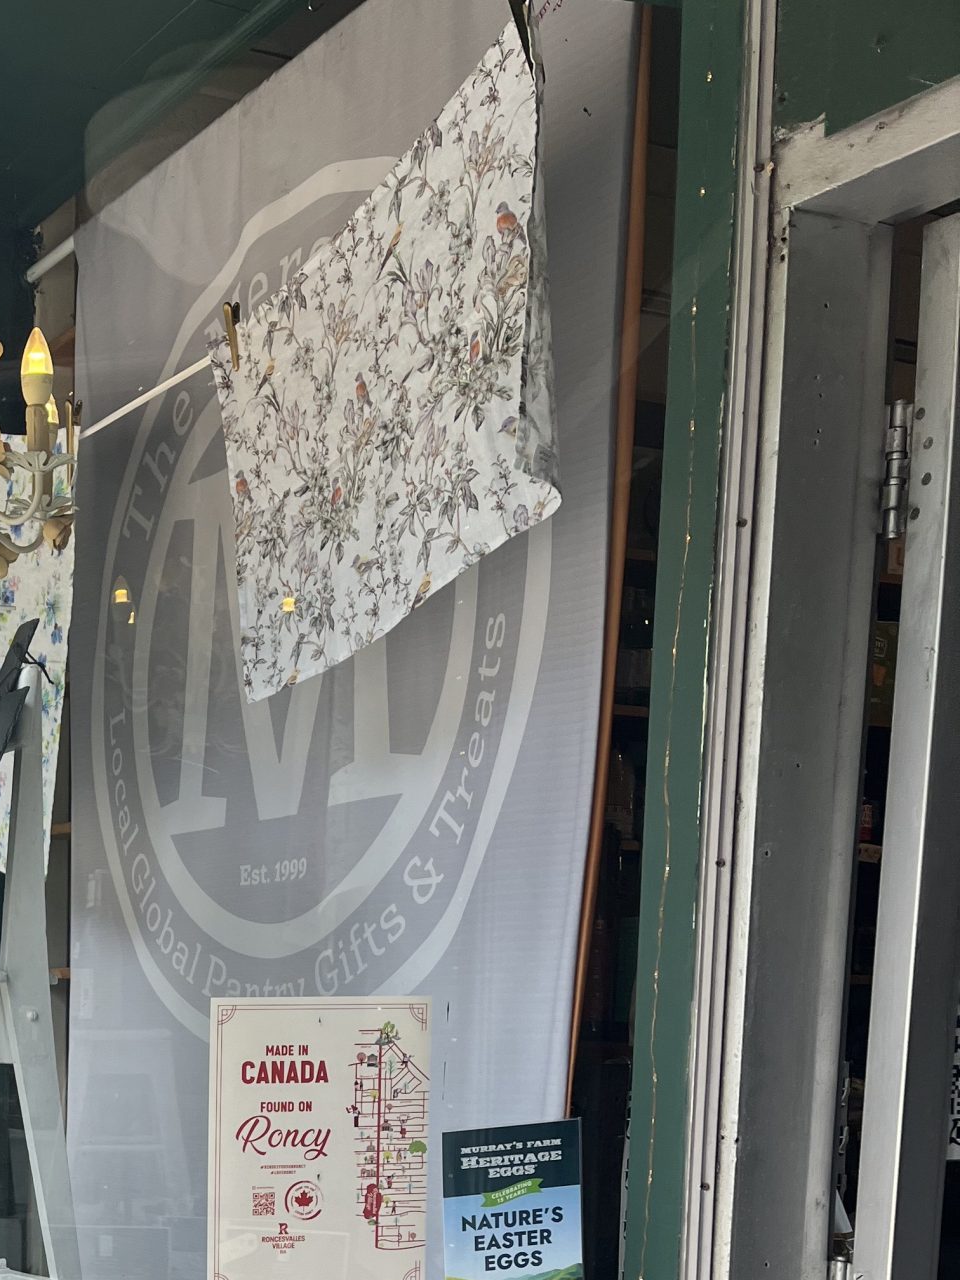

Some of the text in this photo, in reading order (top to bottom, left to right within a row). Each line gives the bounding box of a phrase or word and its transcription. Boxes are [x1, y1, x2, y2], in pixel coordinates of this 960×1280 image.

[122, 390, 193, 541] The
[109, 612, 505, 997] Local Global Pantry Gifts & Treats
[240, 857, 307, 886] Est. 1999
[266, 1044, 309, 1057] MADE IN
[241, 1060, 329, 1084] CANADA
[260, 1101, 312, 1113] FOUND ON
[235, 1115, 331, 1161] Roncy
[460, 1138, 562, 1154] MURRAY'S FARM
[460, 1150, 562, 1170] HERITAGE
[488, 1164, 536, 1178] EGGS
[491, 1180, 532, 1199] CELEBRATING
[505, 1188, 527, 1200] YEARS!
[461, 1206, 564, 1233] NATURE'S
[474, 1229, 552, 1252] EASTER
[484, 1250, 543, 1272] EGGS
